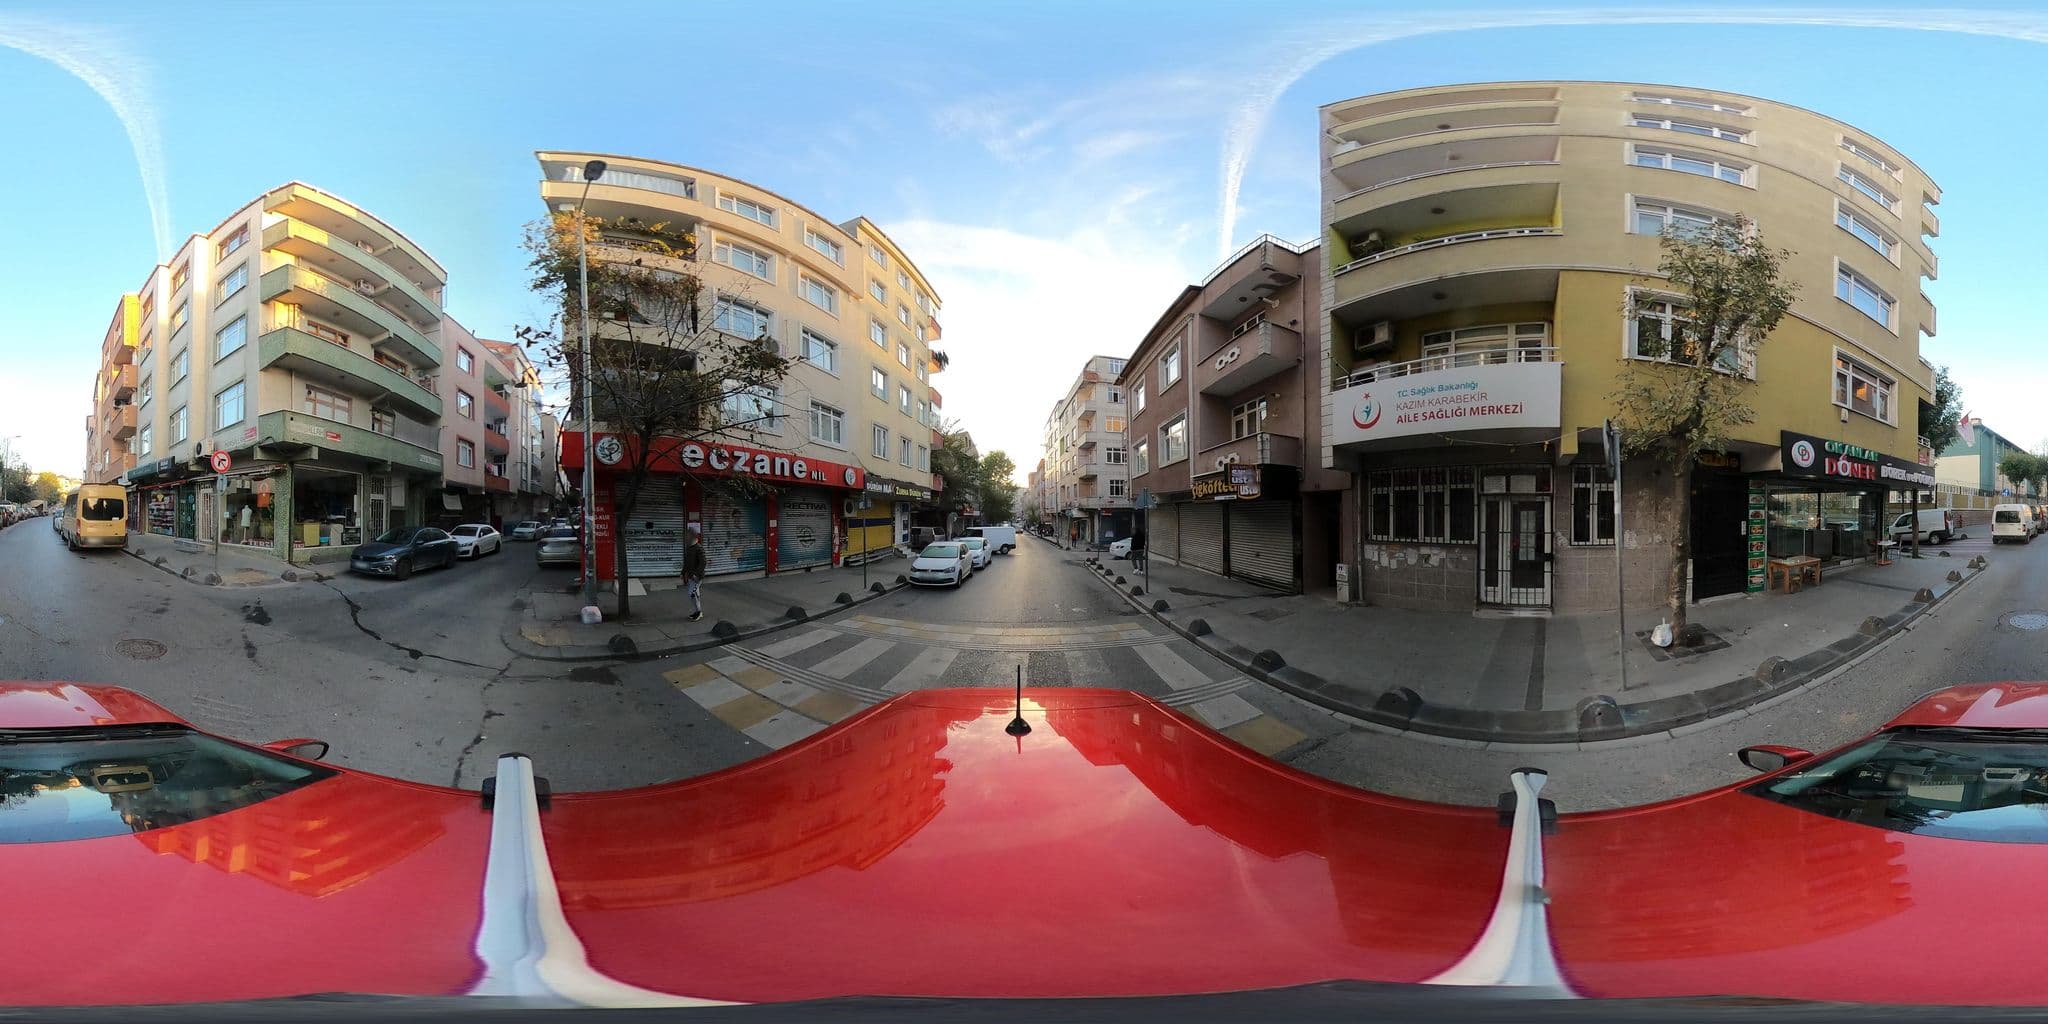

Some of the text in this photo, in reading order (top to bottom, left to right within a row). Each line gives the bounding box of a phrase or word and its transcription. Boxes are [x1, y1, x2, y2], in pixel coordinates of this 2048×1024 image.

[1410, 387, 1436, 396] Sağlık
[1438, 381, 1478, 392] Bakanlığı
[1396, 391, 1488, 411] KAZIM KARABEKİR
[1397, 402, 1522, 424] AİLE SAĞLIĞI MERKEZİ
[682, 444, 808, 478] eczane
[1825, 454, 1876, 480] DÖNER
